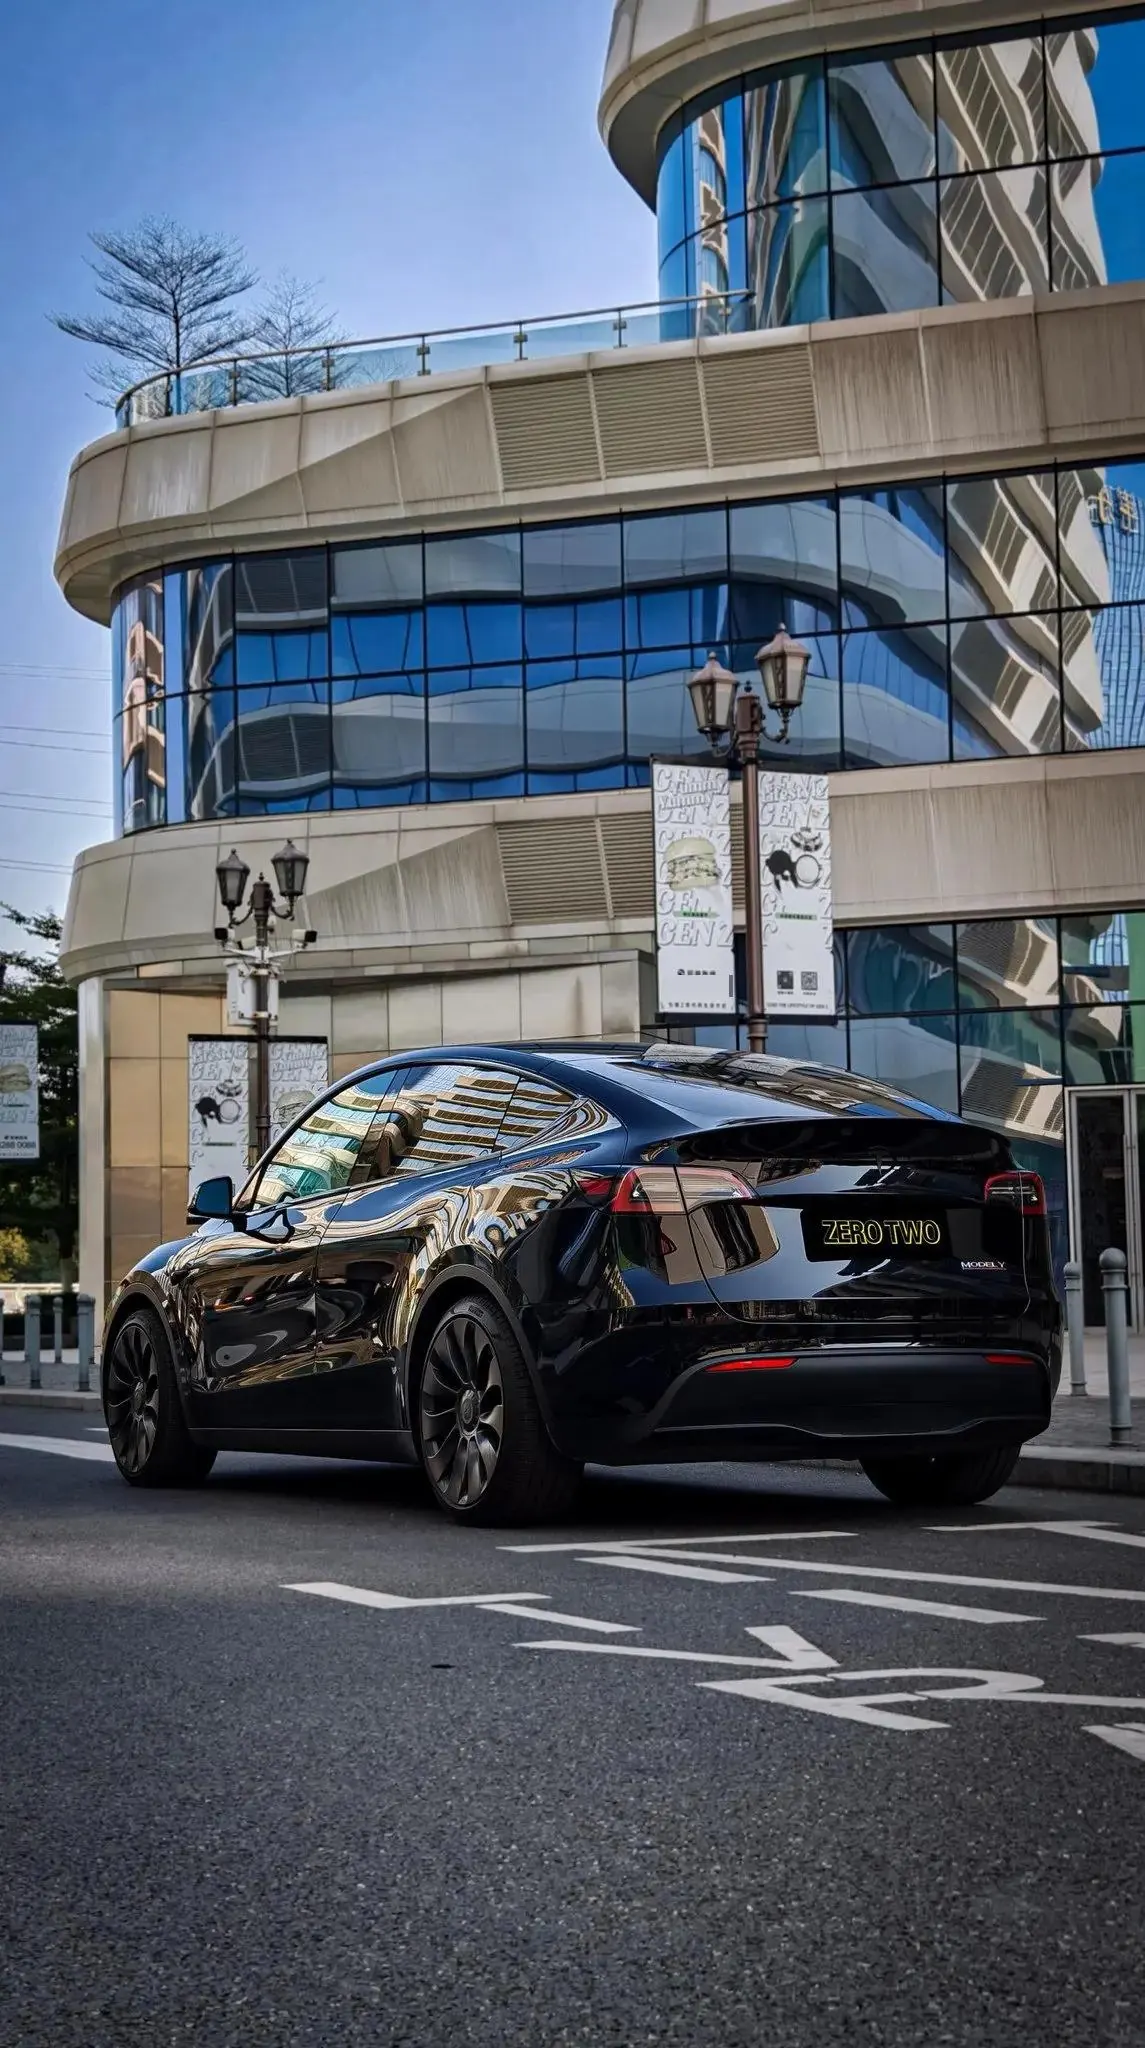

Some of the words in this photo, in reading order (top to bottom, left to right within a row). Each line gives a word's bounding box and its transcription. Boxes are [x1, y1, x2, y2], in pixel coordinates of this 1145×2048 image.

[657, 919, 716, 947] GEN
[717, 921, 735, 948] Z
[821, 1219, 883, 1245] ZERO
[883, 1219, 941, 1245] TWO
[960, 1261, 996, 1269] MODEL
[997, 1261, 1006, 1269] Y
